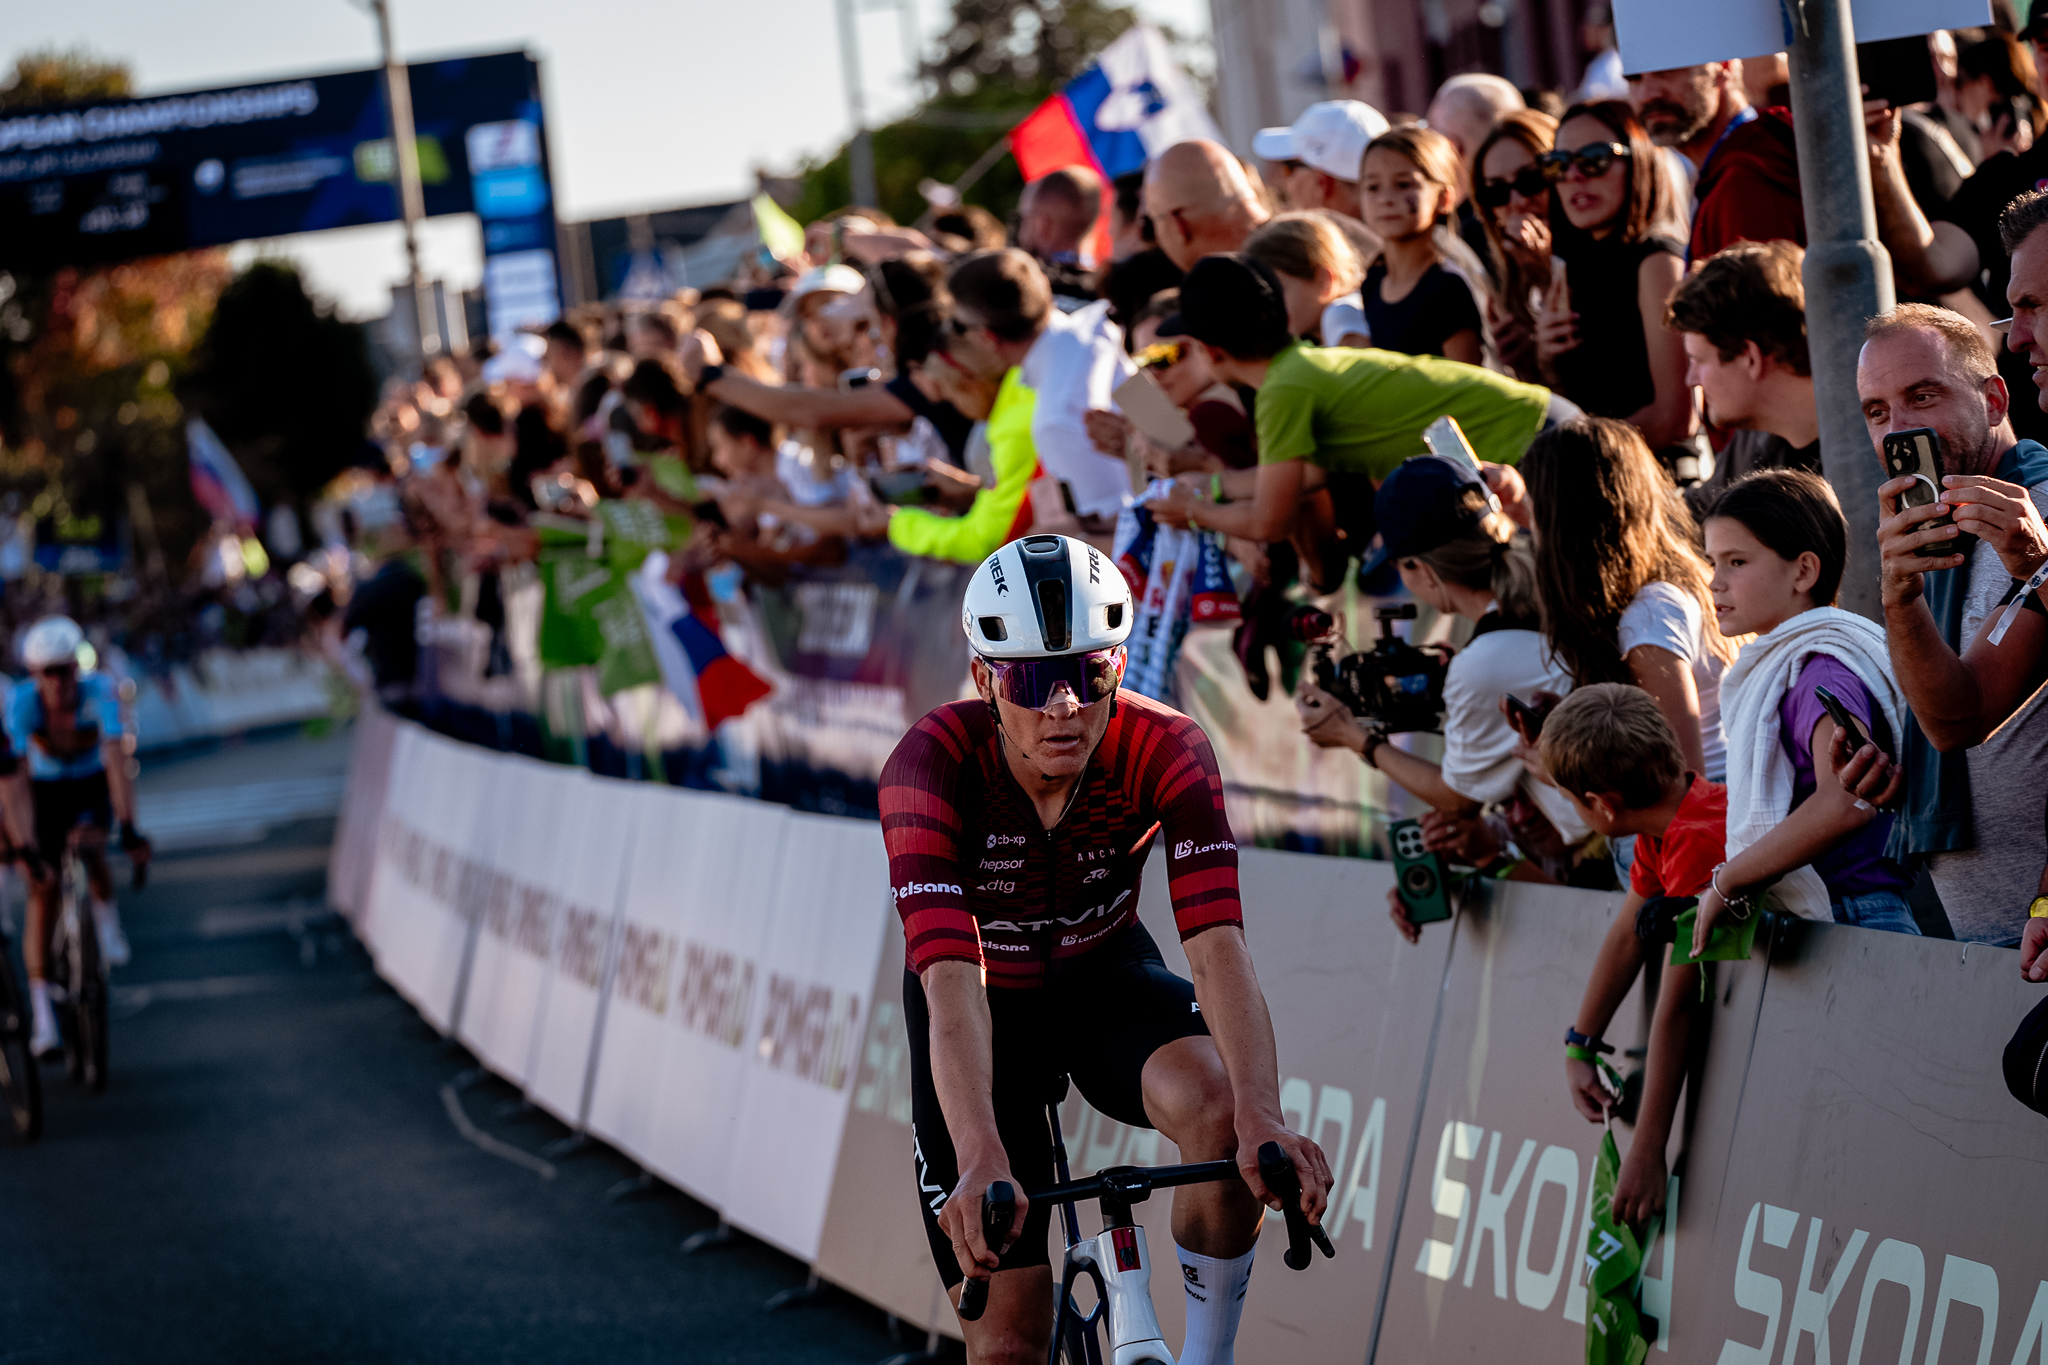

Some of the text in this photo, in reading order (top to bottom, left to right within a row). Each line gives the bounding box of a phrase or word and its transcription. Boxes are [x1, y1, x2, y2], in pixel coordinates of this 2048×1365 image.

[988, 553, 1009, 597] TREK
[979, 858, 1025, 872] hepsor
[899, 881, 963, 899] elsana
[986, 879, 1016, 893] dtg
[980, 889, 1132, 932] ATVIA
